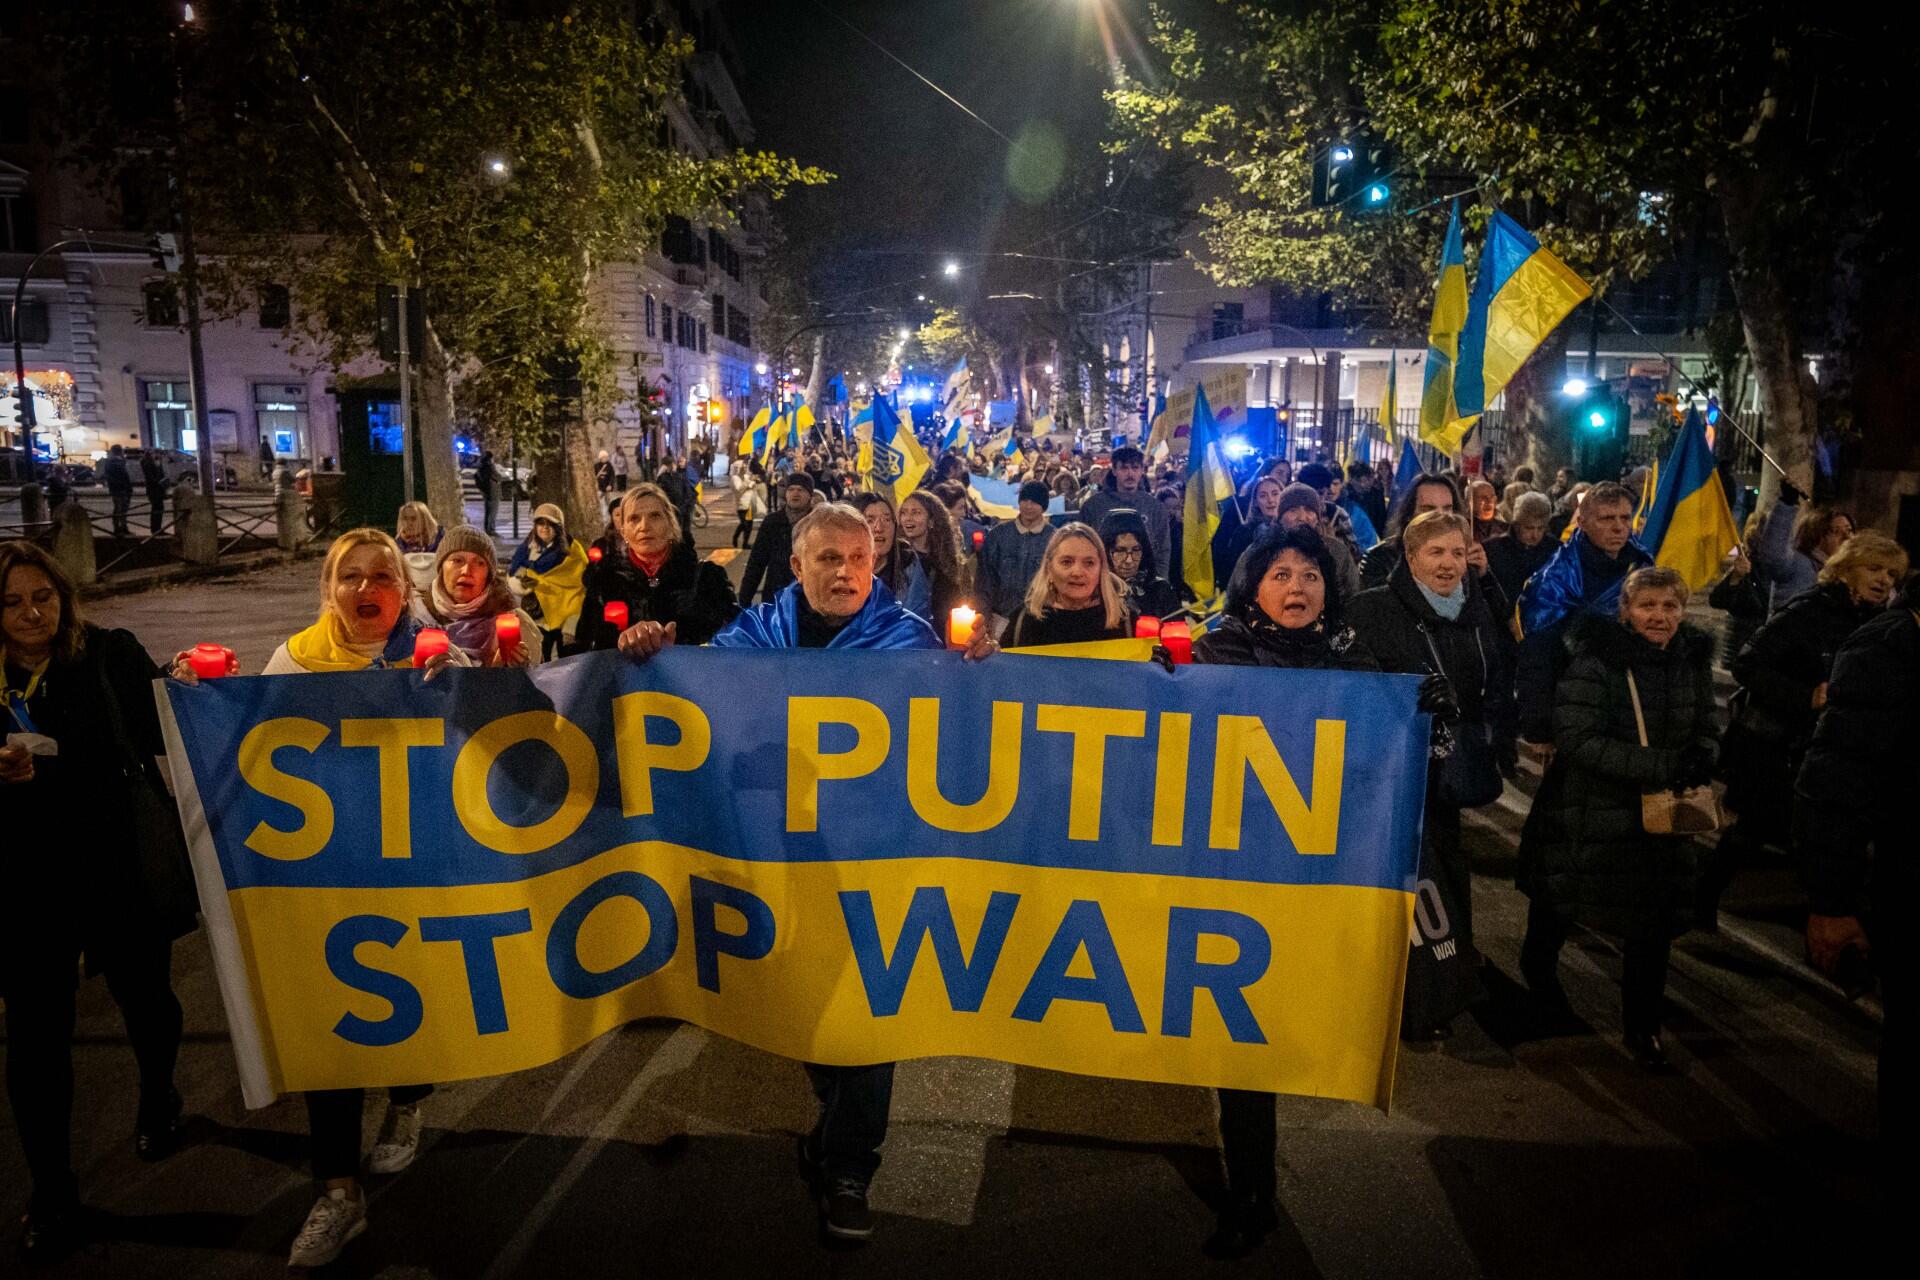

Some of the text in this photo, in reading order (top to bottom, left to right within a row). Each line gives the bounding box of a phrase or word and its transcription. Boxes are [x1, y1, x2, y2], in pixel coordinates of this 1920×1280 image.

[237, 691, 1347, 861] STOP PUTIN
[324, 870, 1272, 1047] STOP WAR
[1432, 938, 1457, 961] WAY
